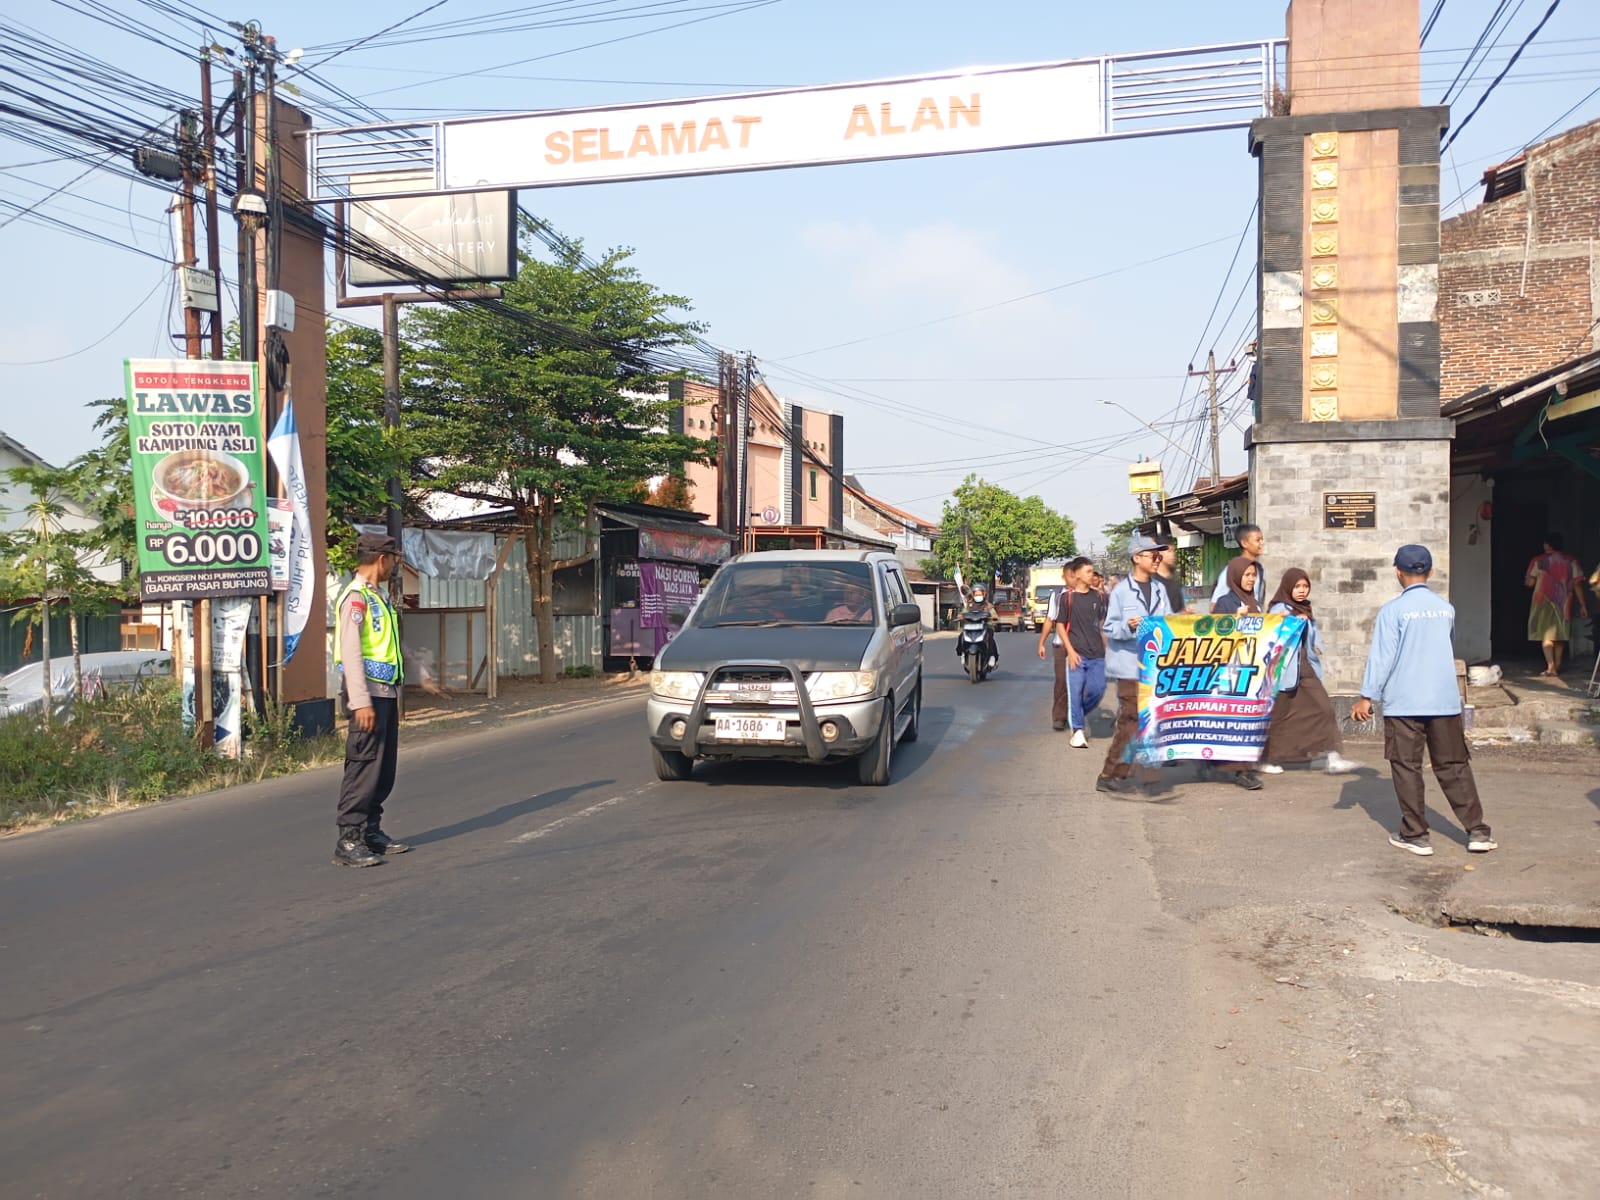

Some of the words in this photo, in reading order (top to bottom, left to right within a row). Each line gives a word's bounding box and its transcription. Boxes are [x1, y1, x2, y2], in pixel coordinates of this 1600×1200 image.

[543, 115, 763, 165] SELAMAT
[843, 93, 983, 140] ALAN
[438, 240, 496, 256] EATERY
[138, 376, 168, 385] SOTO
[184, 377, 248, 386] TENGKLENG
[136, 393, 252, 414] LAWAS
[151, 423, 196, 437] SOTO
[200, 424, 241, 437] AYAM
[139, 438, 217, 452] KAMPUNG
[222, 438, 255, 452] ASLI
[146, 521, 172, 531] hanya
[187, 510, 254, 529] 10.000
[150, 538, 164, 548] RP
[167, 534, 258, 564] 6.000
[158, 573, 196, 582] KONGSEN
[214, 570, 267, 580] PURWOKERTO
[655, 566, 672, 582] NASI
[673, 569, 700, 585] GORENG
[145, 583, 183, 594] (BARAT
[187, 580, 220, 591] PASAR
[223, 578, 268, 590] BURUNG)
[288, 597, 300, 613] RS
[1157, 637, 1257, 667] JALAN
[738, 682, 771, 691] ISUZU
[1156, 666, 1258, 696] SEHAT
[1185, 702, 1227, 711] RAMAH
[1230, 704, 1267, 713] TERP
[717, 719, 730, 730] AA
[736, 720, 763, 731] 1686
[776, 720, 783, 732] A
[1173, 720, 1225, 729] KESATRIAN
[1195, 733, 1243, 742] KESATRIAN
